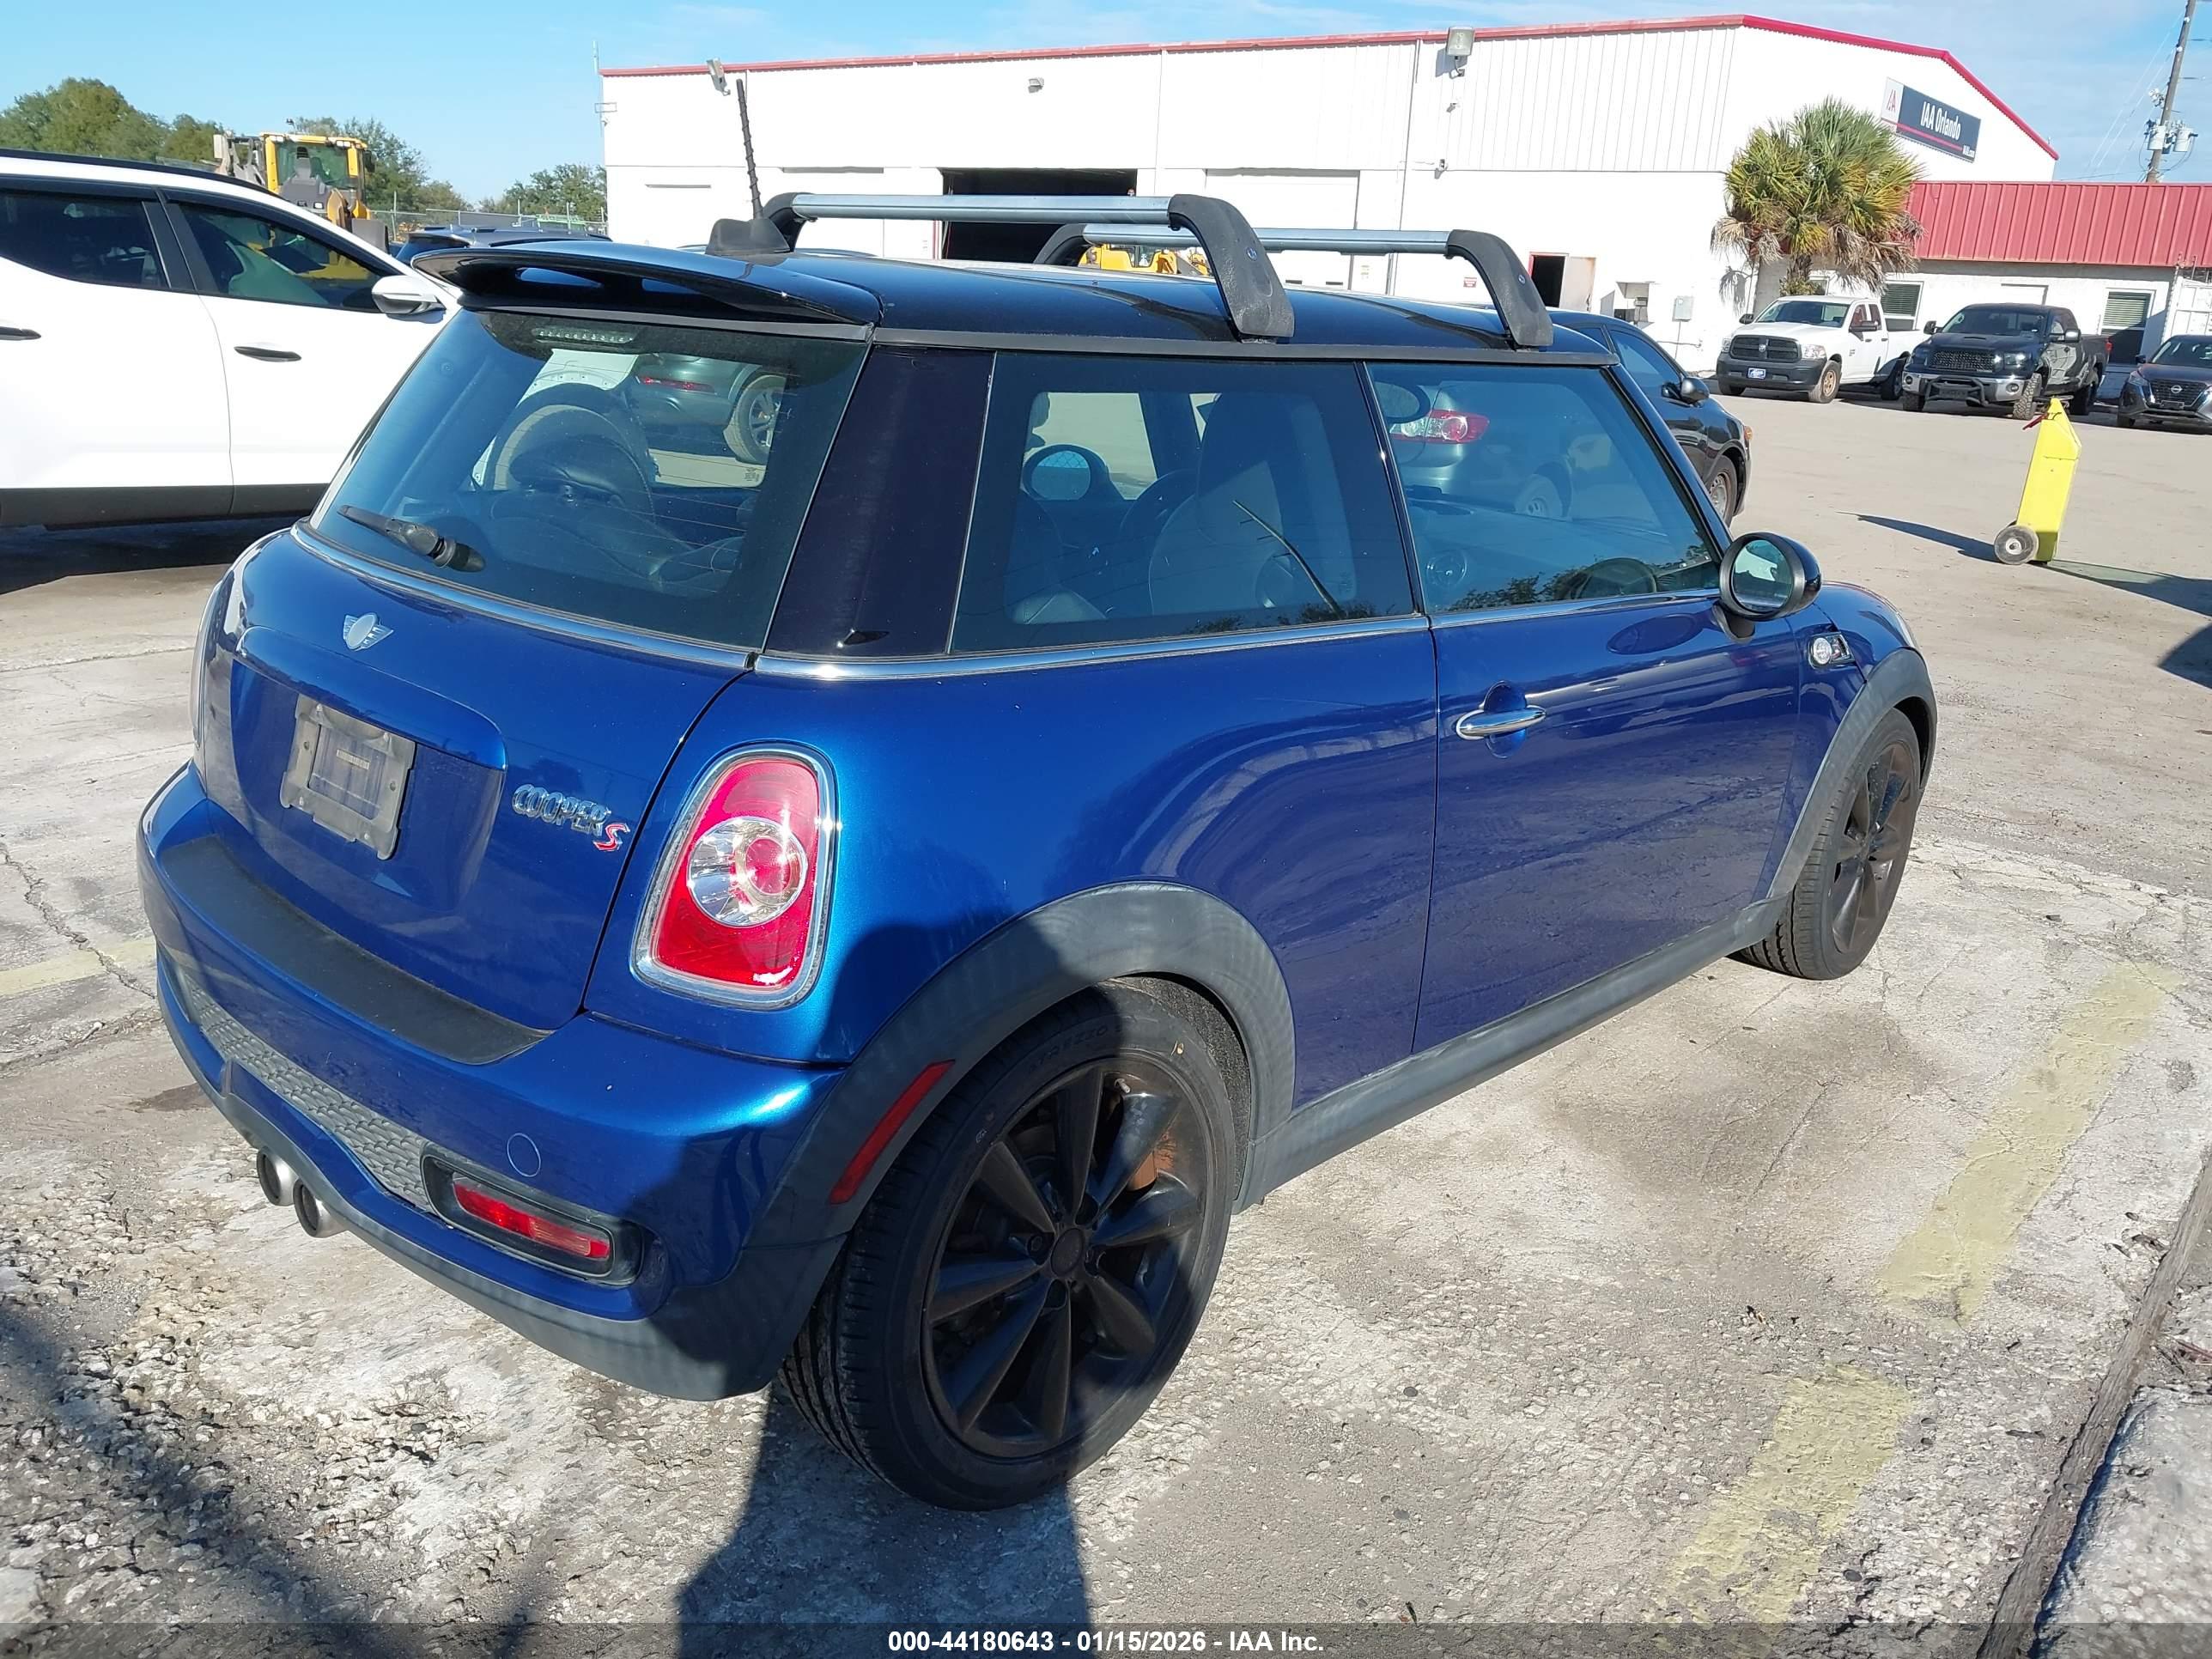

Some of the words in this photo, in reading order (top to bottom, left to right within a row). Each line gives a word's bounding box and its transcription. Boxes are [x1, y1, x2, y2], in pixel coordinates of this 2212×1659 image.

[1920, 101, 1936, 130] IAA
[1935, 107, 1961, 140] Orlando
[512, 783, 612, 837] COOPER
[592, 822, 631, 852] S
